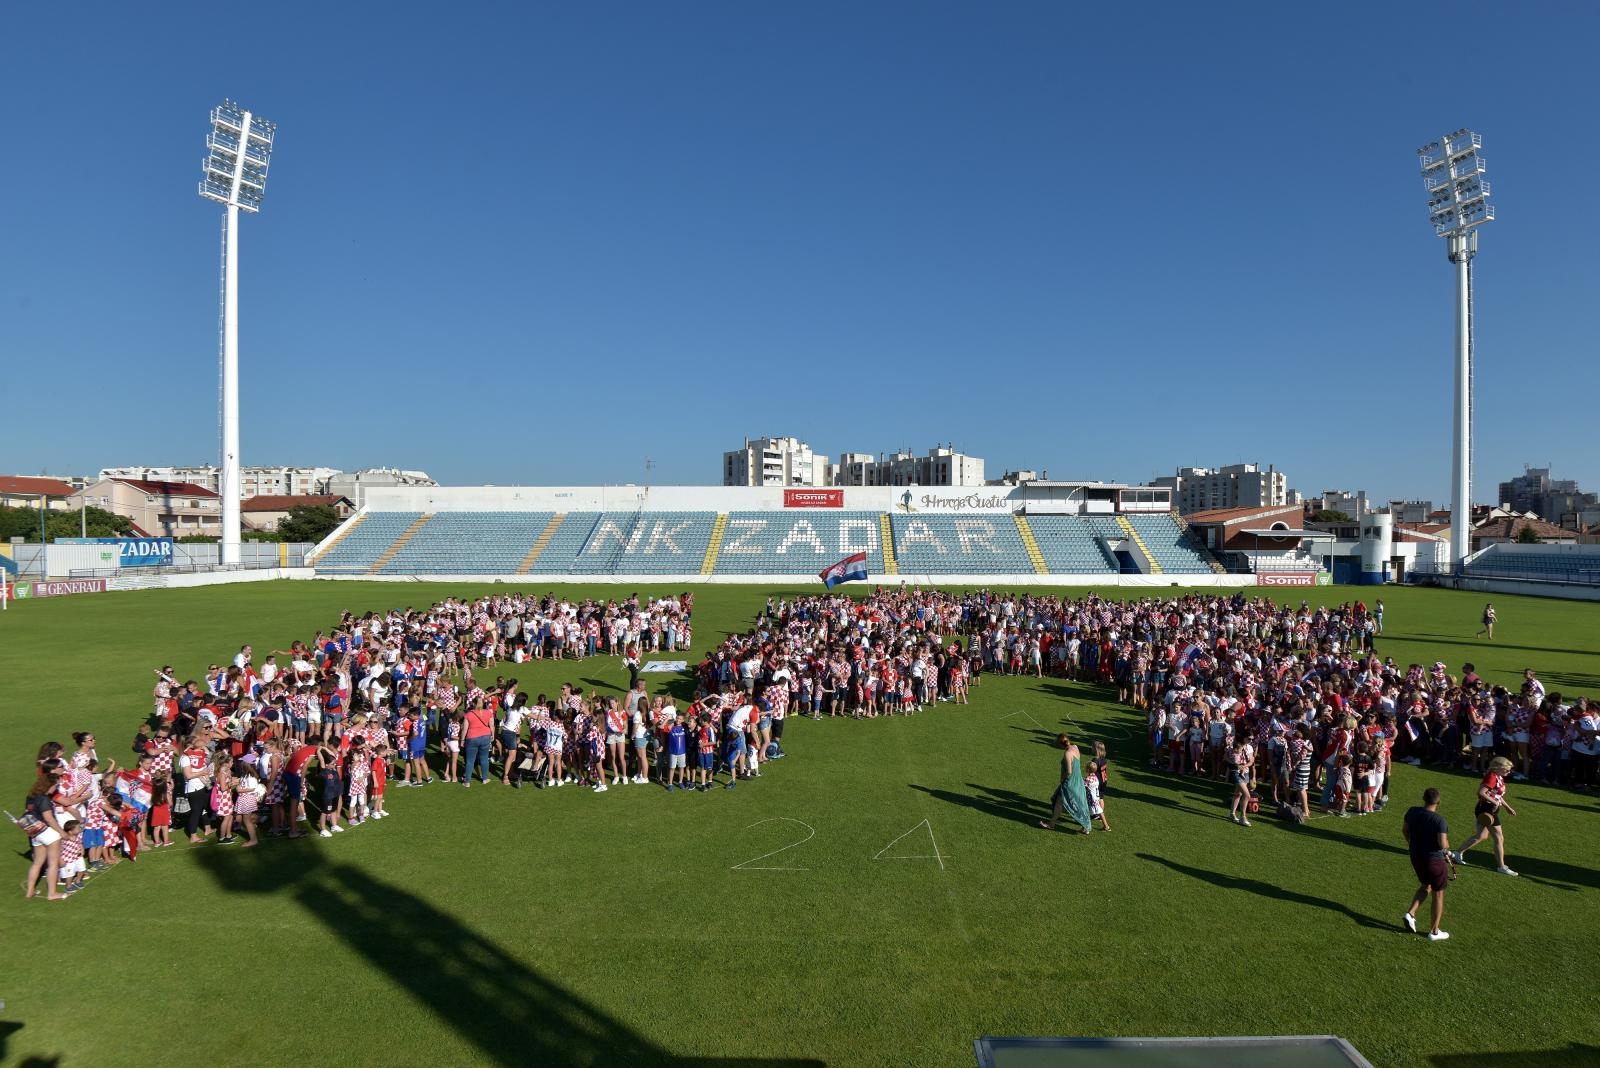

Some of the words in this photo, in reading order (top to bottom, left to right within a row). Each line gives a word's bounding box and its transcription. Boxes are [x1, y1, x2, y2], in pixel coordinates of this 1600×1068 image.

[921, 494, 965, 510] Hrvoje
[587, 520, 693, 553] NK
[724, 519, 1004, 554] ZADAR
[119, 541, 171, 557] ZADAR
[48, 580, 101, 595] GENERALI
[548, 732, 560, 746] 17
